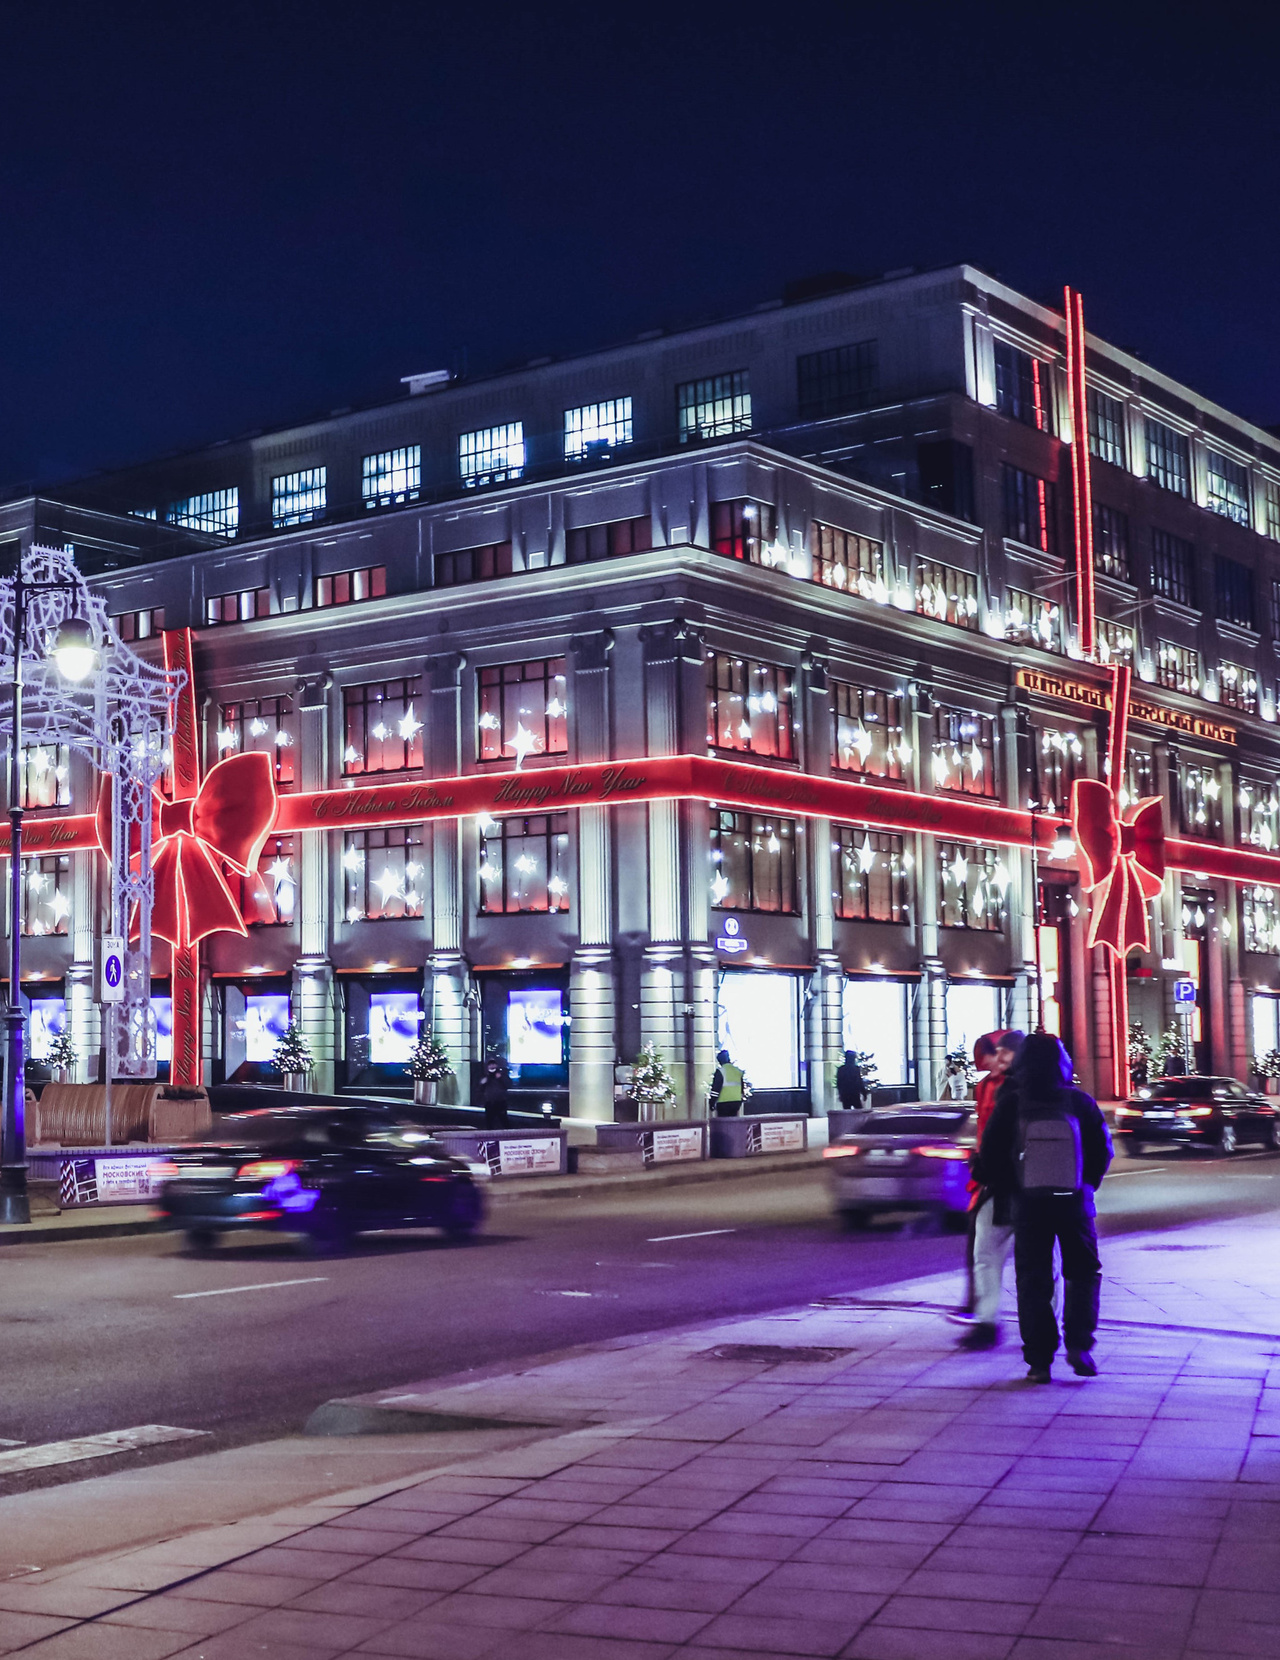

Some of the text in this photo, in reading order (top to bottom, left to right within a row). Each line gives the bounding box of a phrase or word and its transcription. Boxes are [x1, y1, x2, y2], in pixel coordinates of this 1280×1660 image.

[494, 766, 646, 807] Happy New Year
[311, 786, 453, 817] С Новым Годом
[47, 822, 78, 849] Year
[1180, 983, 1192, 1000] P
